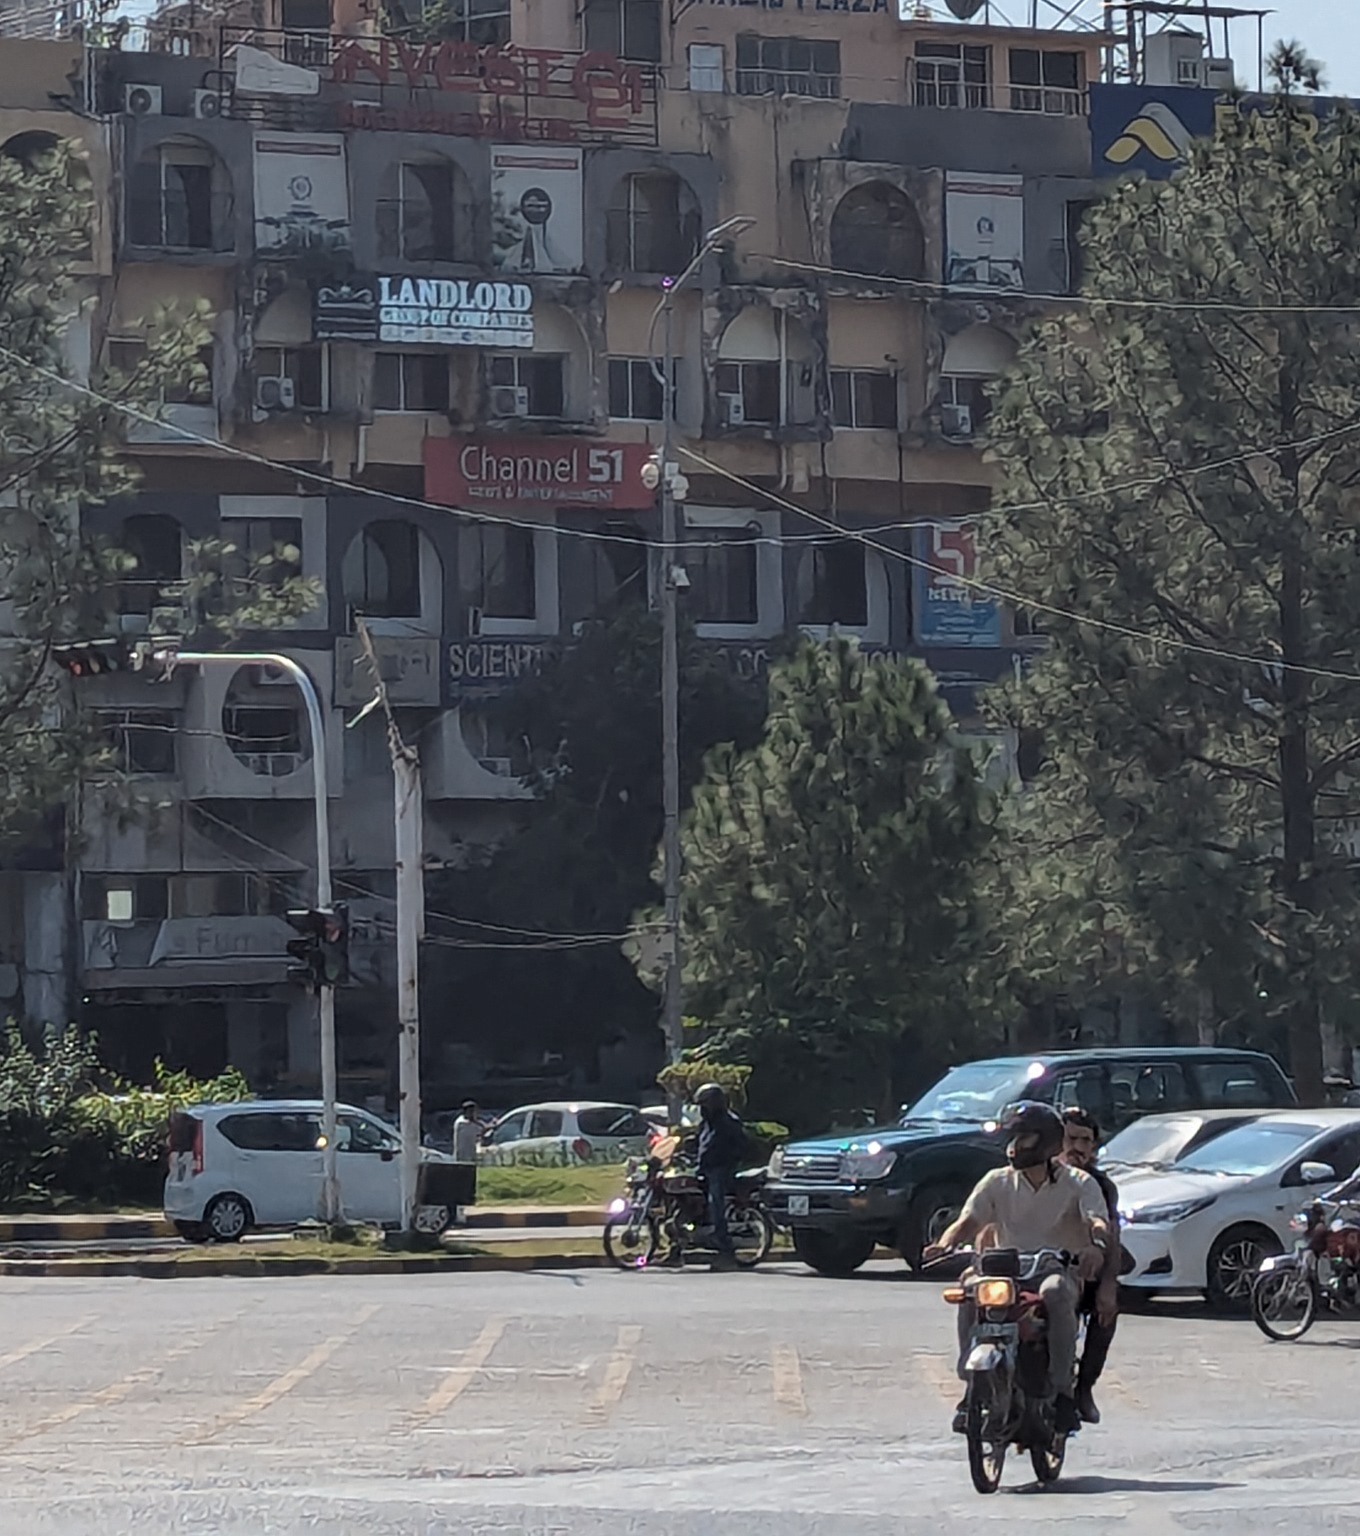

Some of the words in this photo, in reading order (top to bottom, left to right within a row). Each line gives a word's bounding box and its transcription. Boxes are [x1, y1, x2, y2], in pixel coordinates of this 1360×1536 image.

[377, 276, 533, 312] LANDLORD
[459, 445, 578, 483] Channel
[588, 448, 624, 482] 51
